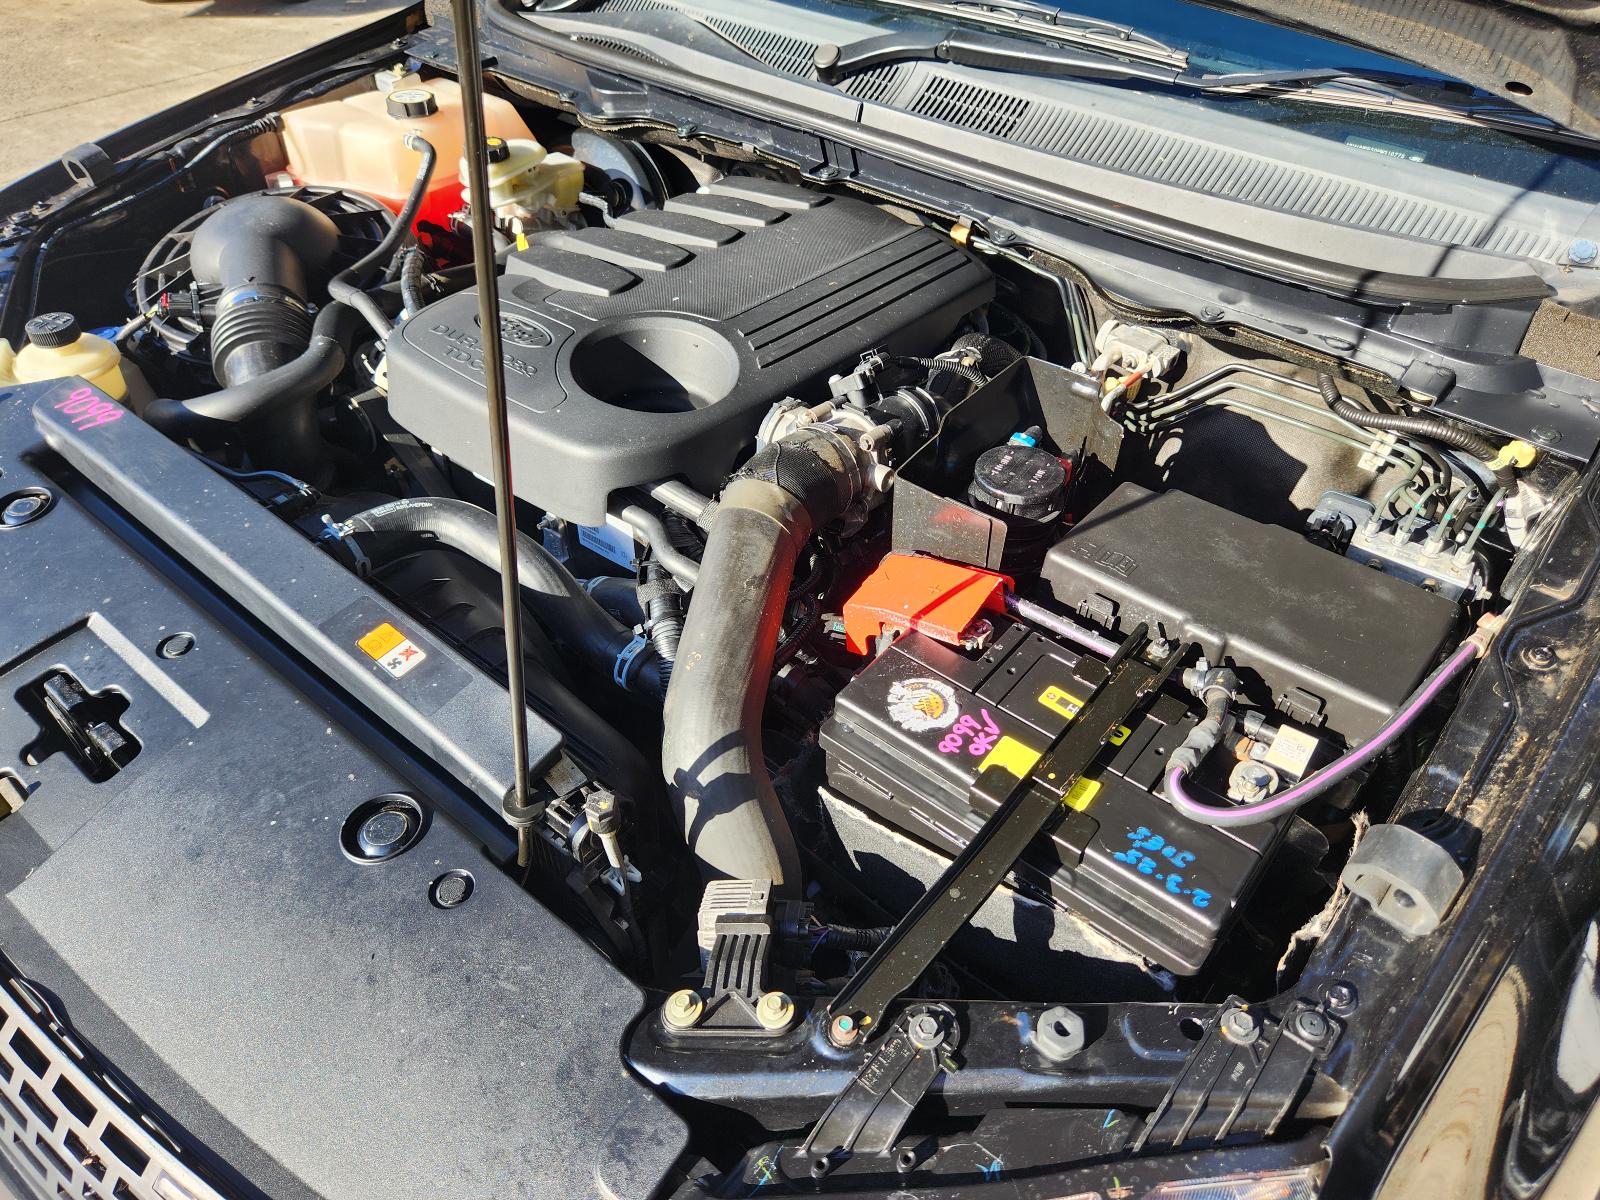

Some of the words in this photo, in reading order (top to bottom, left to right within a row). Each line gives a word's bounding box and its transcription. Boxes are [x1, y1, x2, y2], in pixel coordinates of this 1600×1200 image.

[428, 324, 538, 378] DURORQ
[54, 387, 124, 431] 9099
[938, 714, 982, 753] 9099
